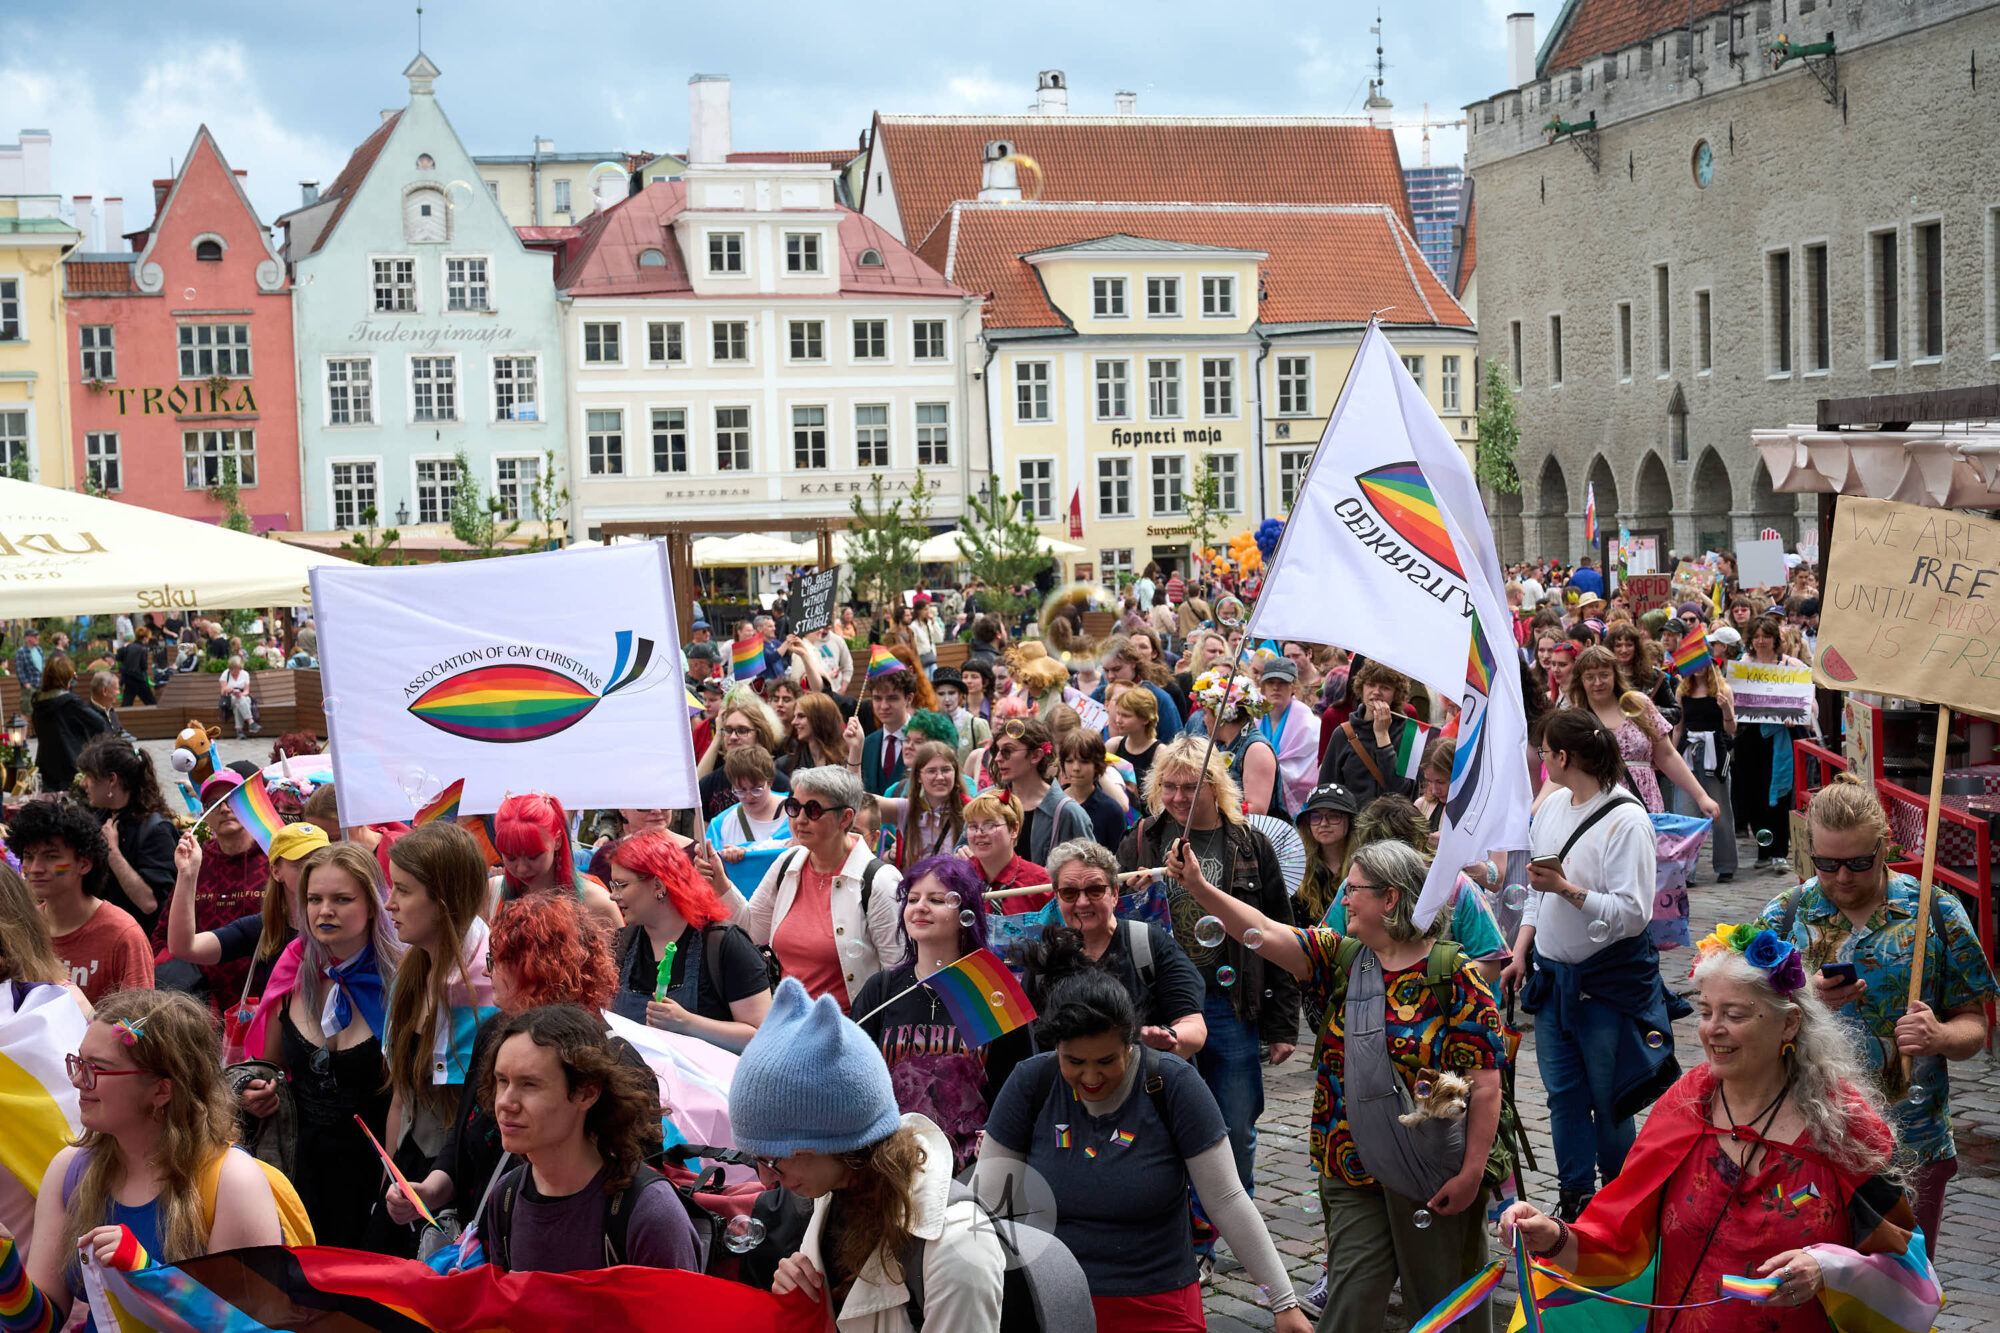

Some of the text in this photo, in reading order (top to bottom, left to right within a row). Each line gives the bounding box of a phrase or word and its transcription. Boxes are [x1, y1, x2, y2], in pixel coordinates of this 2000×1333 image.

[348, 320, 516, 349] Tudengimaja
[108, 384, 258, 415] TROIKA
[1112, 426, 1222, 447] Hopneri maja
[800, 479, 941, 493] KAERAJAN
[1853, 507, 1991, 563] WE ARE
[801, 569, 833, 588] NO QUEER
[1909, 555, 1999, 599] FREE
[137, 584, 198, 609] saku
[803, 589, 829, 607] WITHOUT
[1834, 583, 2000, 635] UNTIL EVERY
[793, 612, 830, 635] STRUGGLE
[805, 603, 825, 618] CLASS
[1867, 624, 1904, 659] IS
[1920, 633, 2000, 679] FRE
[403, 645, 602, 698] ASSOCIATION OF GAY CHRISTIANS
[231, 890, 266, 898] HILFIGE
